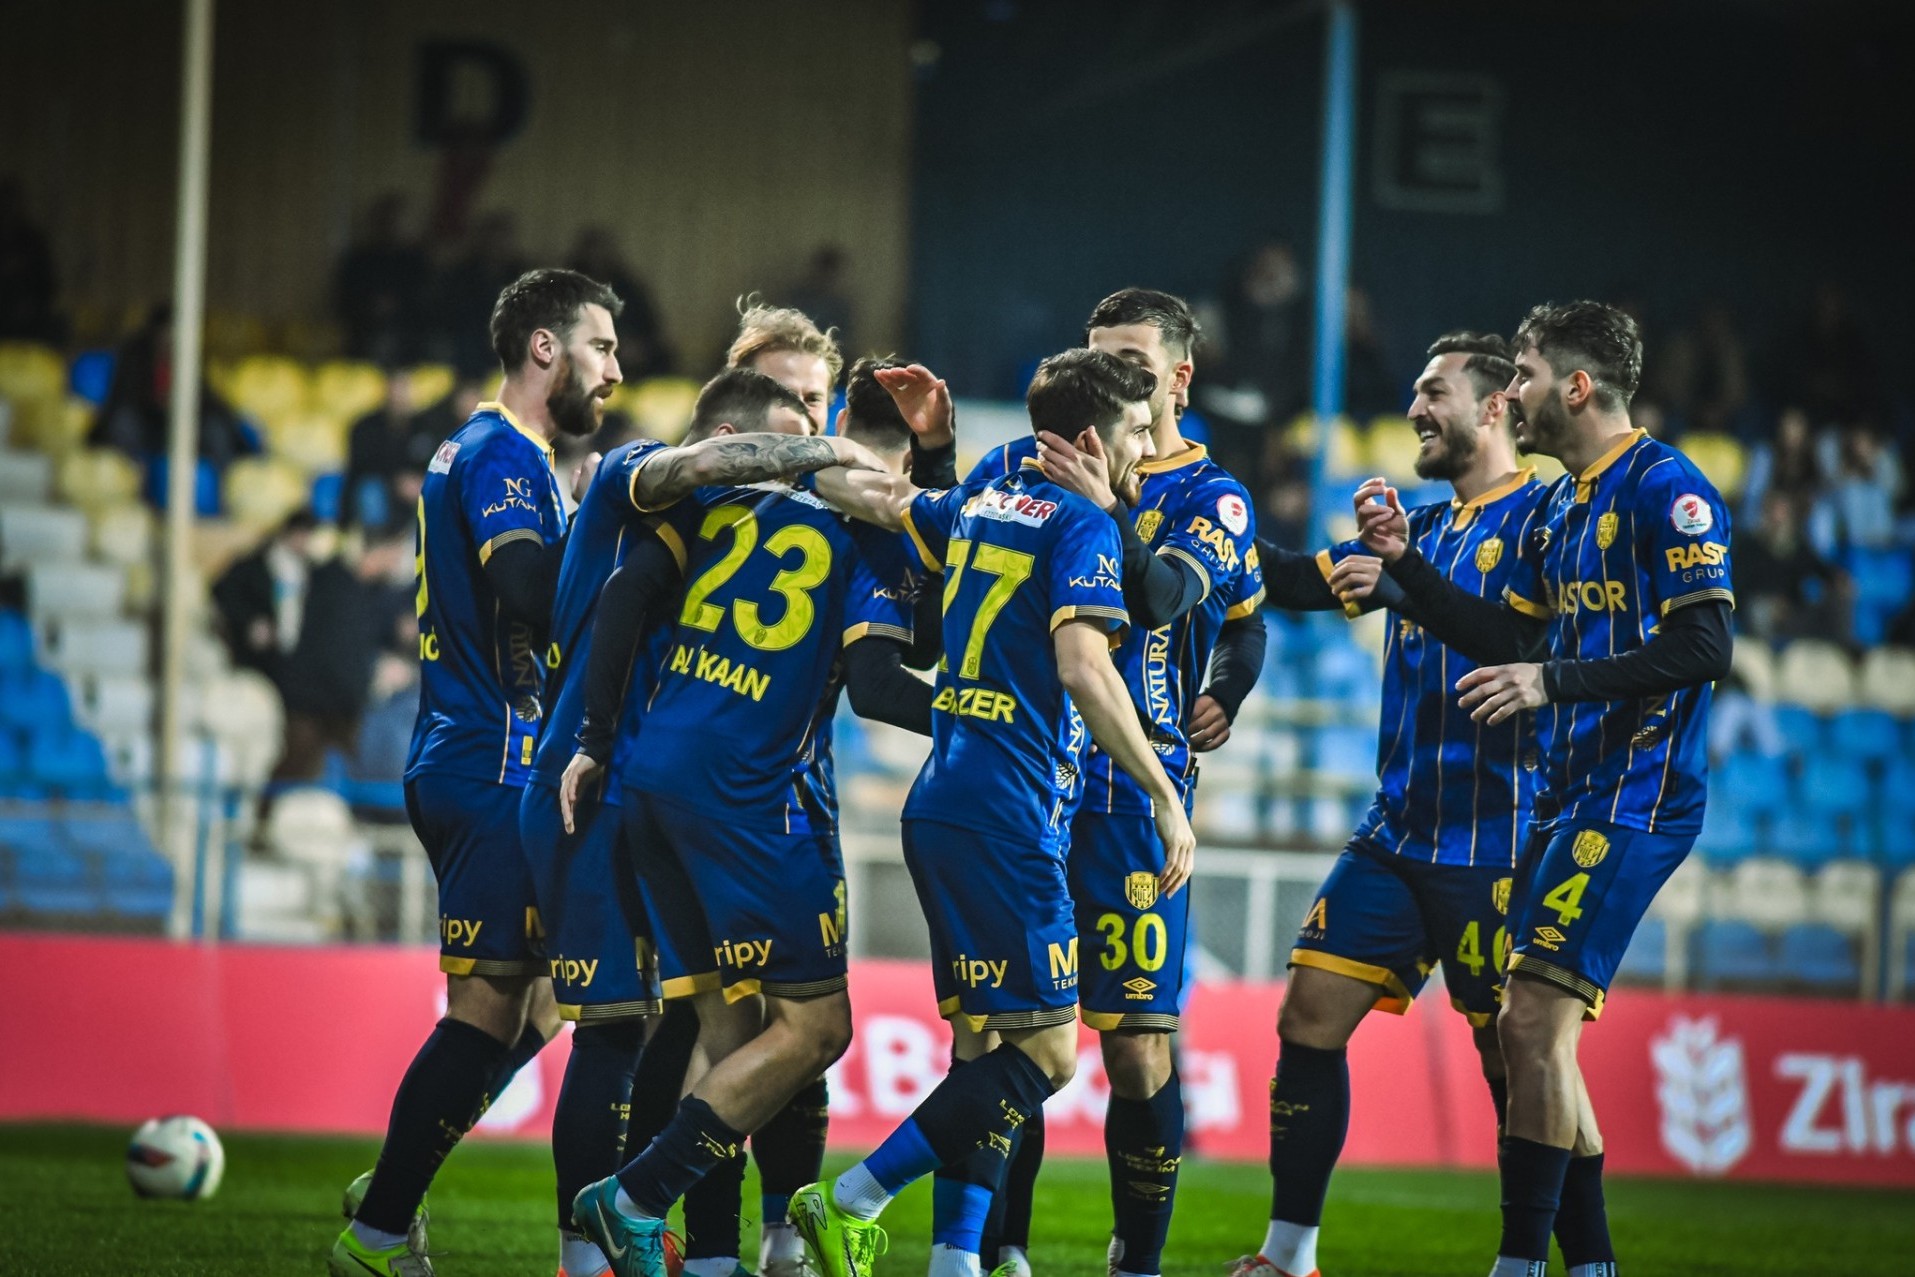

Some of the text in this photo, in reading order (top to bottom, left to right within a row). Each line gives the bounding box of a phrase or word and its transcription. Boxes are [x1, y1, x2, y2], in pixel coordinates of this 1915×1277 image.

[1186, 516, 1240, 573] RAST
[1665, 541, 1728, 573] RAST
[680, 504, 832, 651] 23
[1069, 576, 1122, 591] KUTA
[1682, 568, 1725, 583] GRUP
[938, 537, 1035, 680] 77
[1542, 871, 1590, 926] 4
[714, 939, 772, 970] ripy
[1096, 912, 1168, 972] 30
[1125, 992, 1154, 1001] umbro
